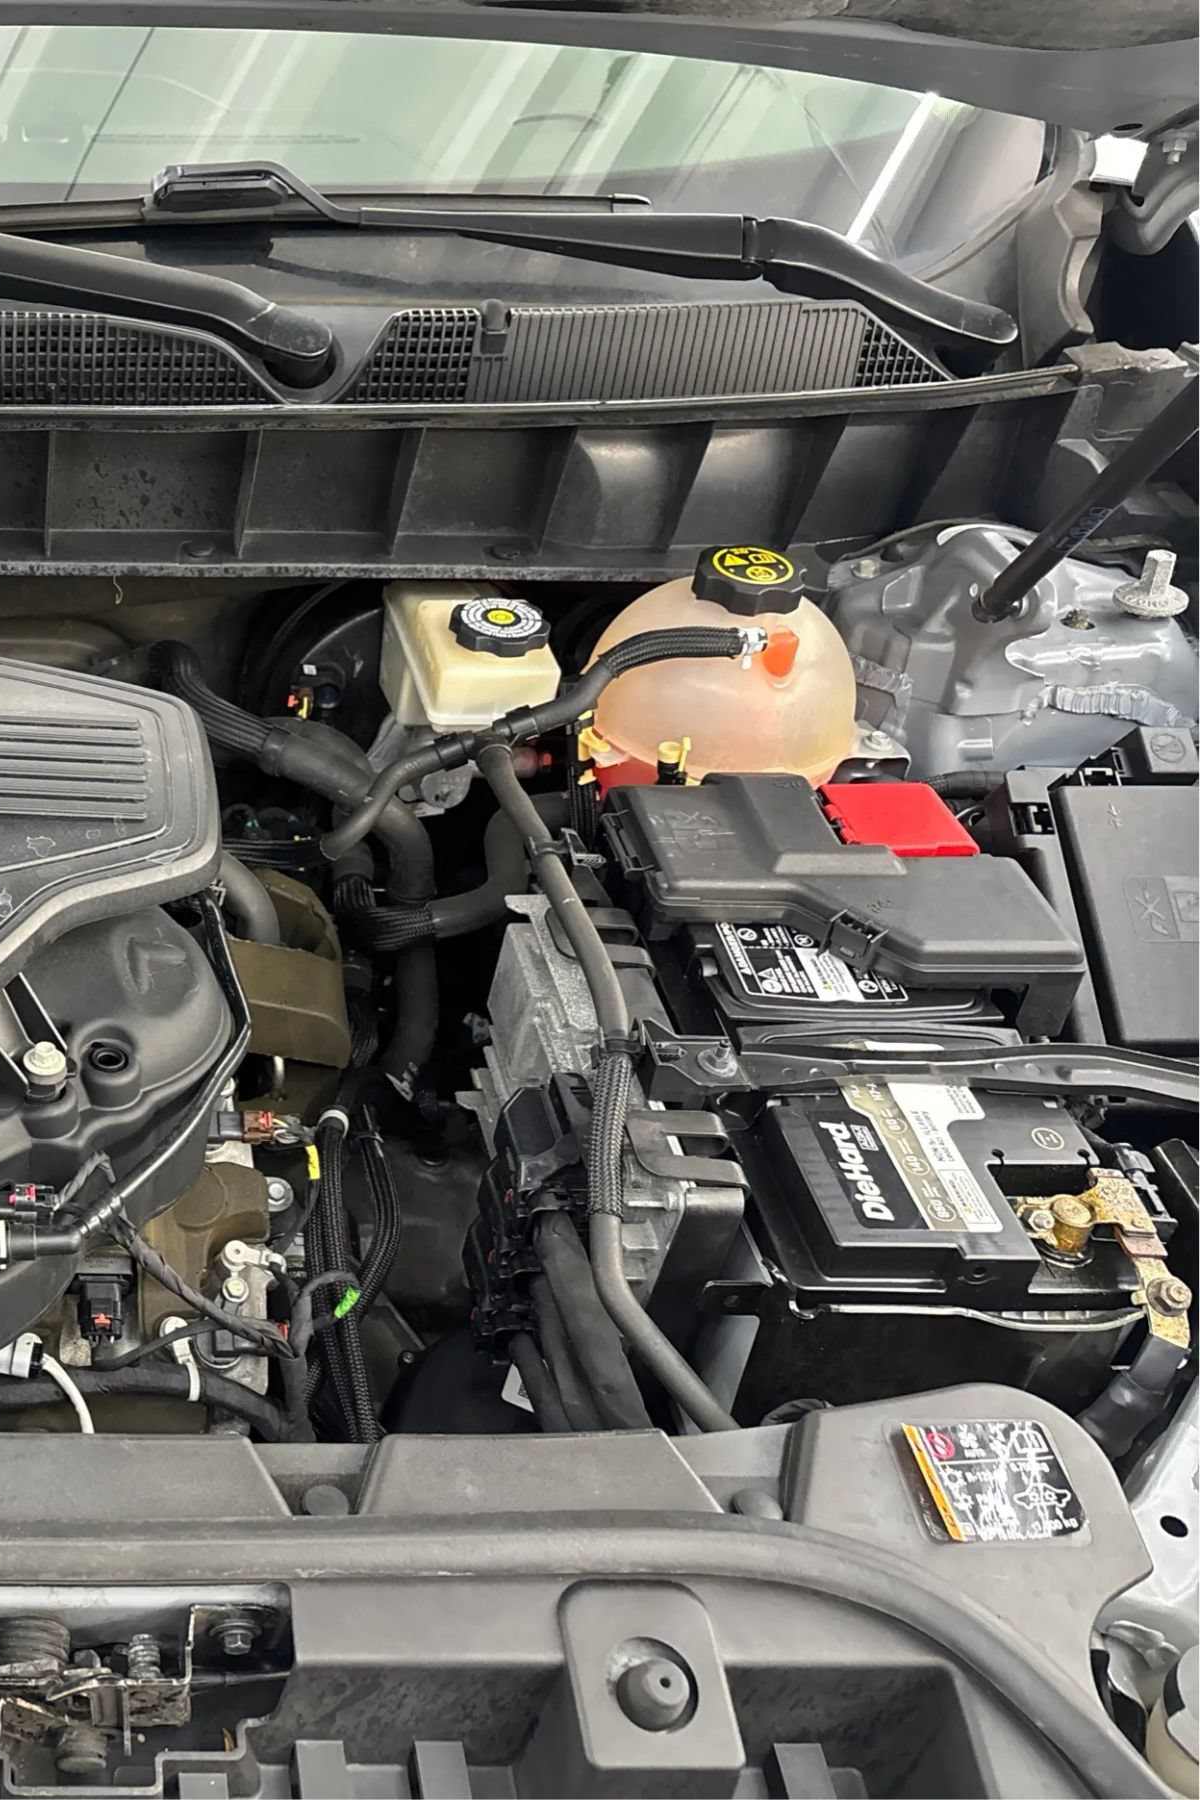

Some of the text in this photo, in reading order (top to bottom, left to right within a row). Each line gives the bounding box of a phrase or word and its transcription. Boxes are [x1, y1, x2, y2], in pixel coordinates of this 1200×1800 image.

[819, 1121, 895, 1222] DieHard
[906, 1155, 924, 1172] 140
[930, 1199, 950, 1218] 850
